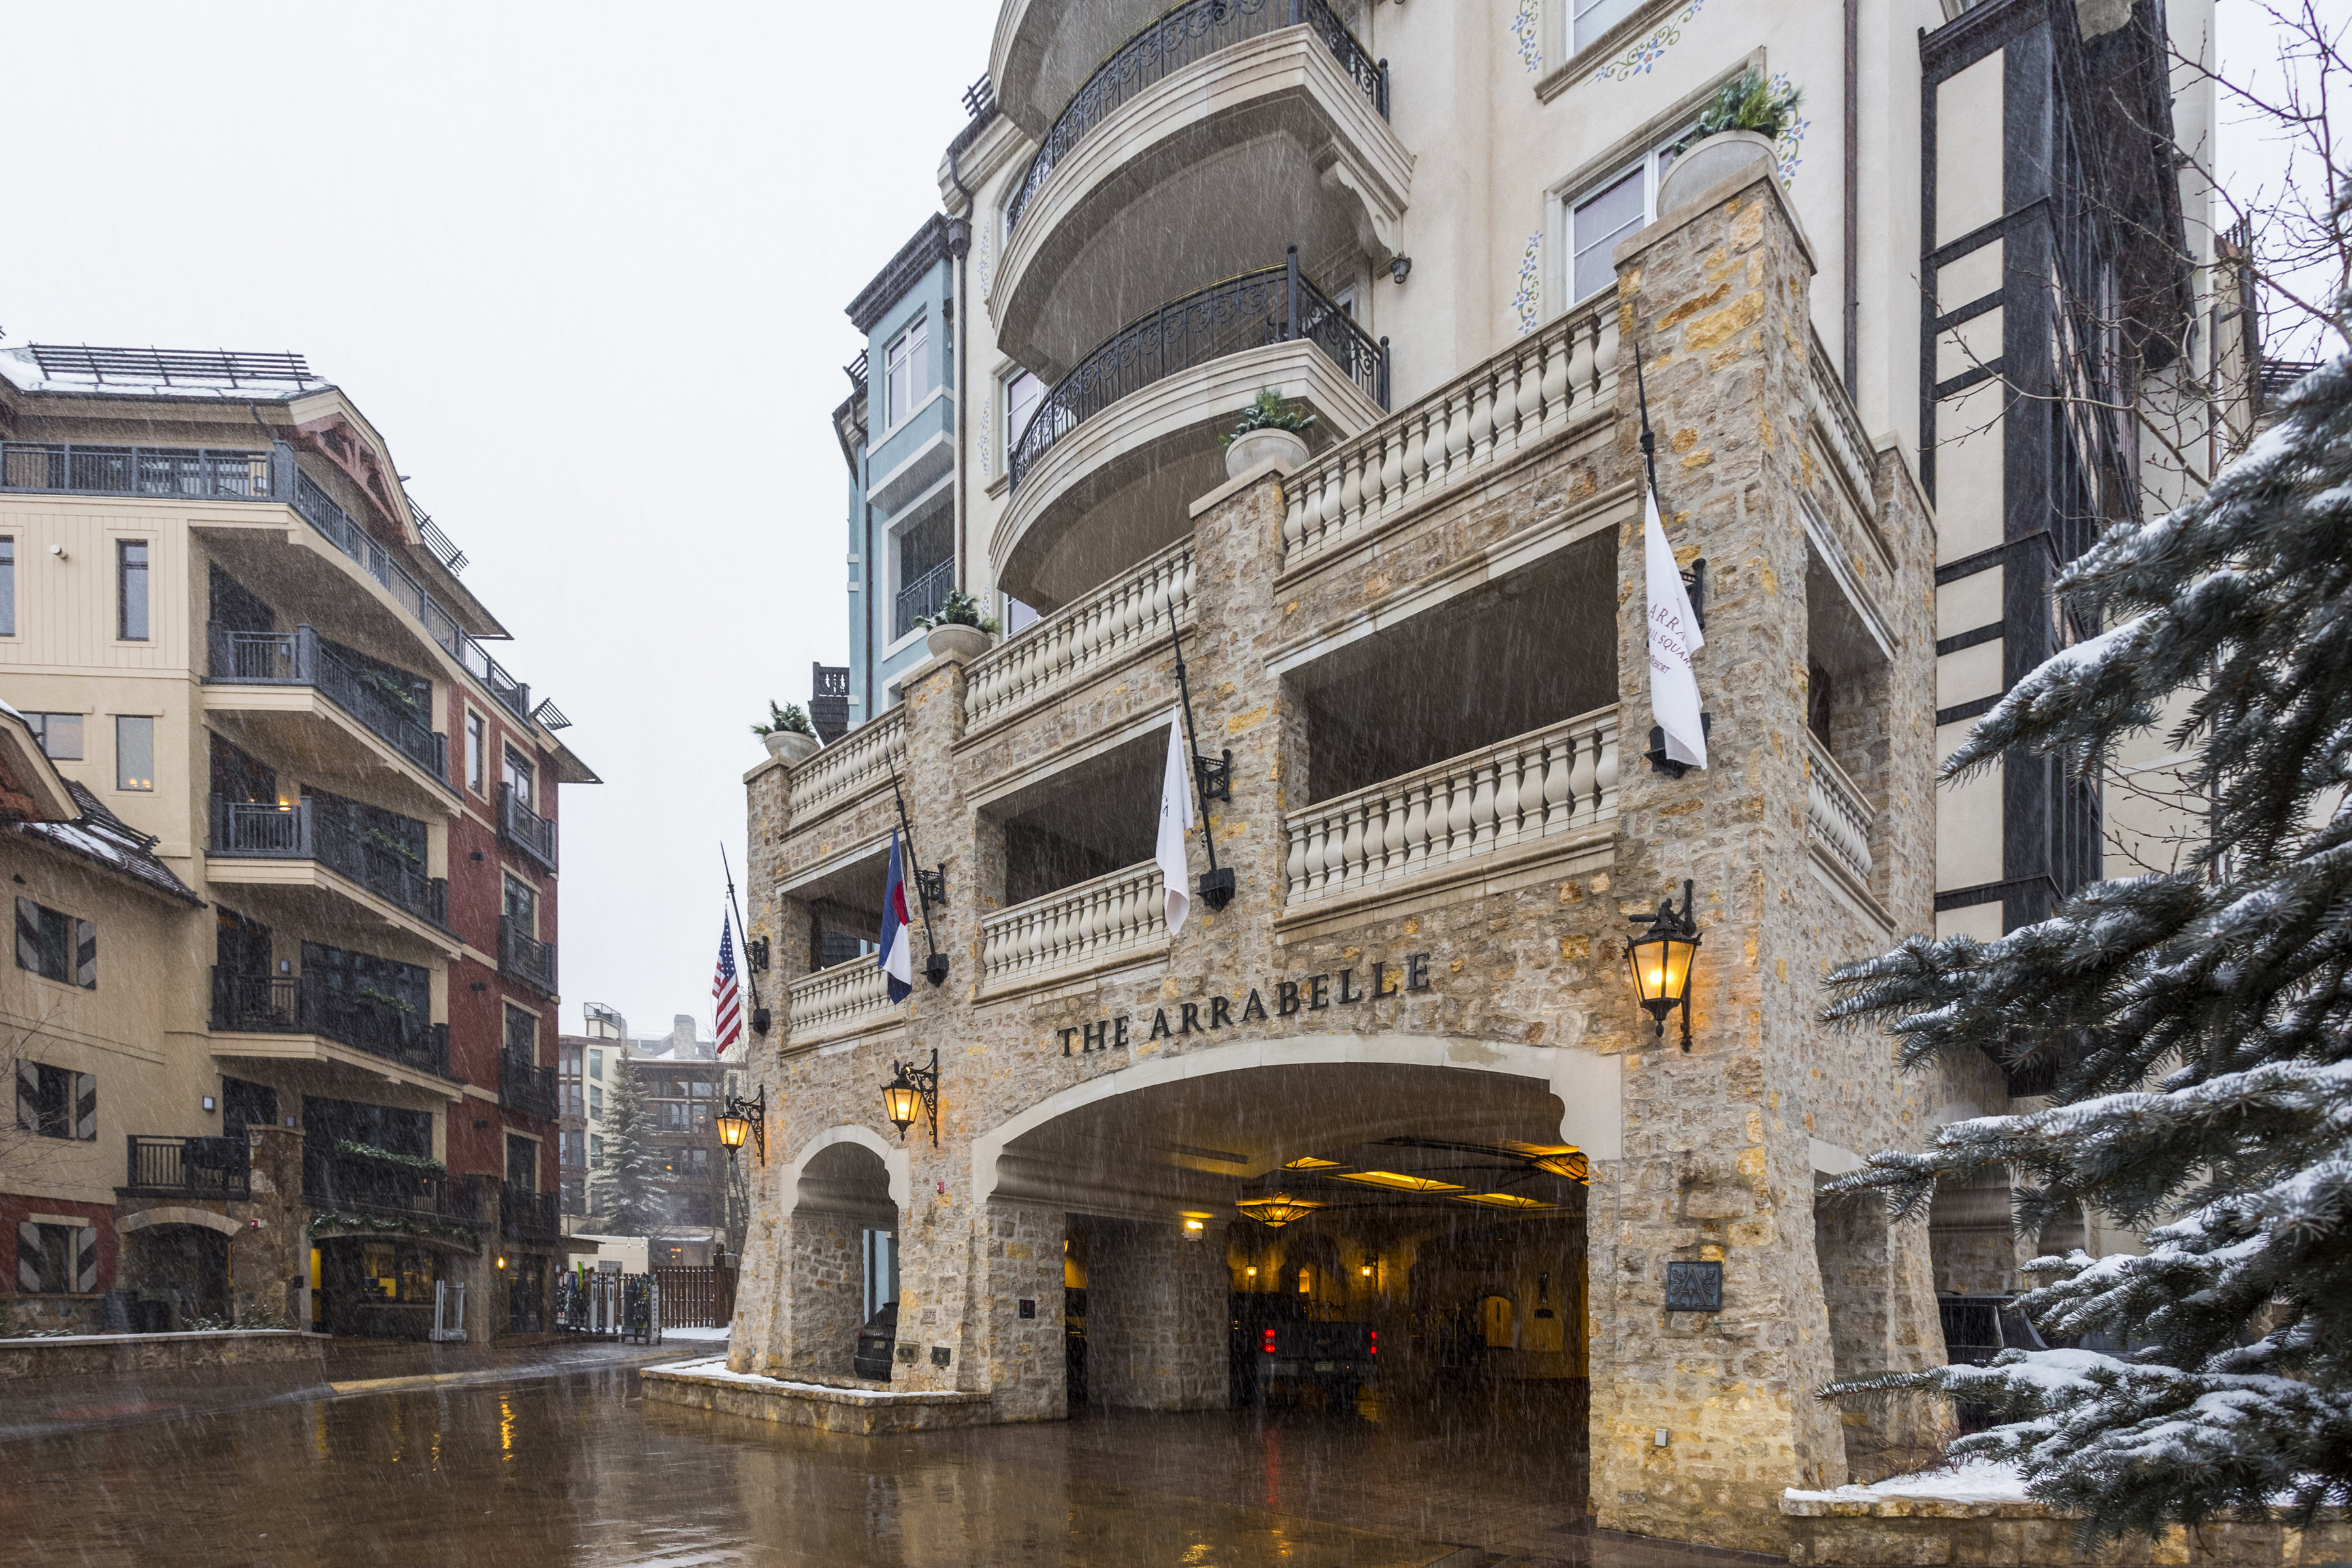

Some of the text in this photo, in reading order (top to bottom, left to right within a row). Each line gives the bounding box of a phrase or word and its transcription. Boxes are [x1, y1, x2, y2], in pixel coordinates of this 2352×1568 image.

[1658, 634, 1692, 669] SQUAR
[1057, 952, 1430, 1056] THE ARRABELLE
